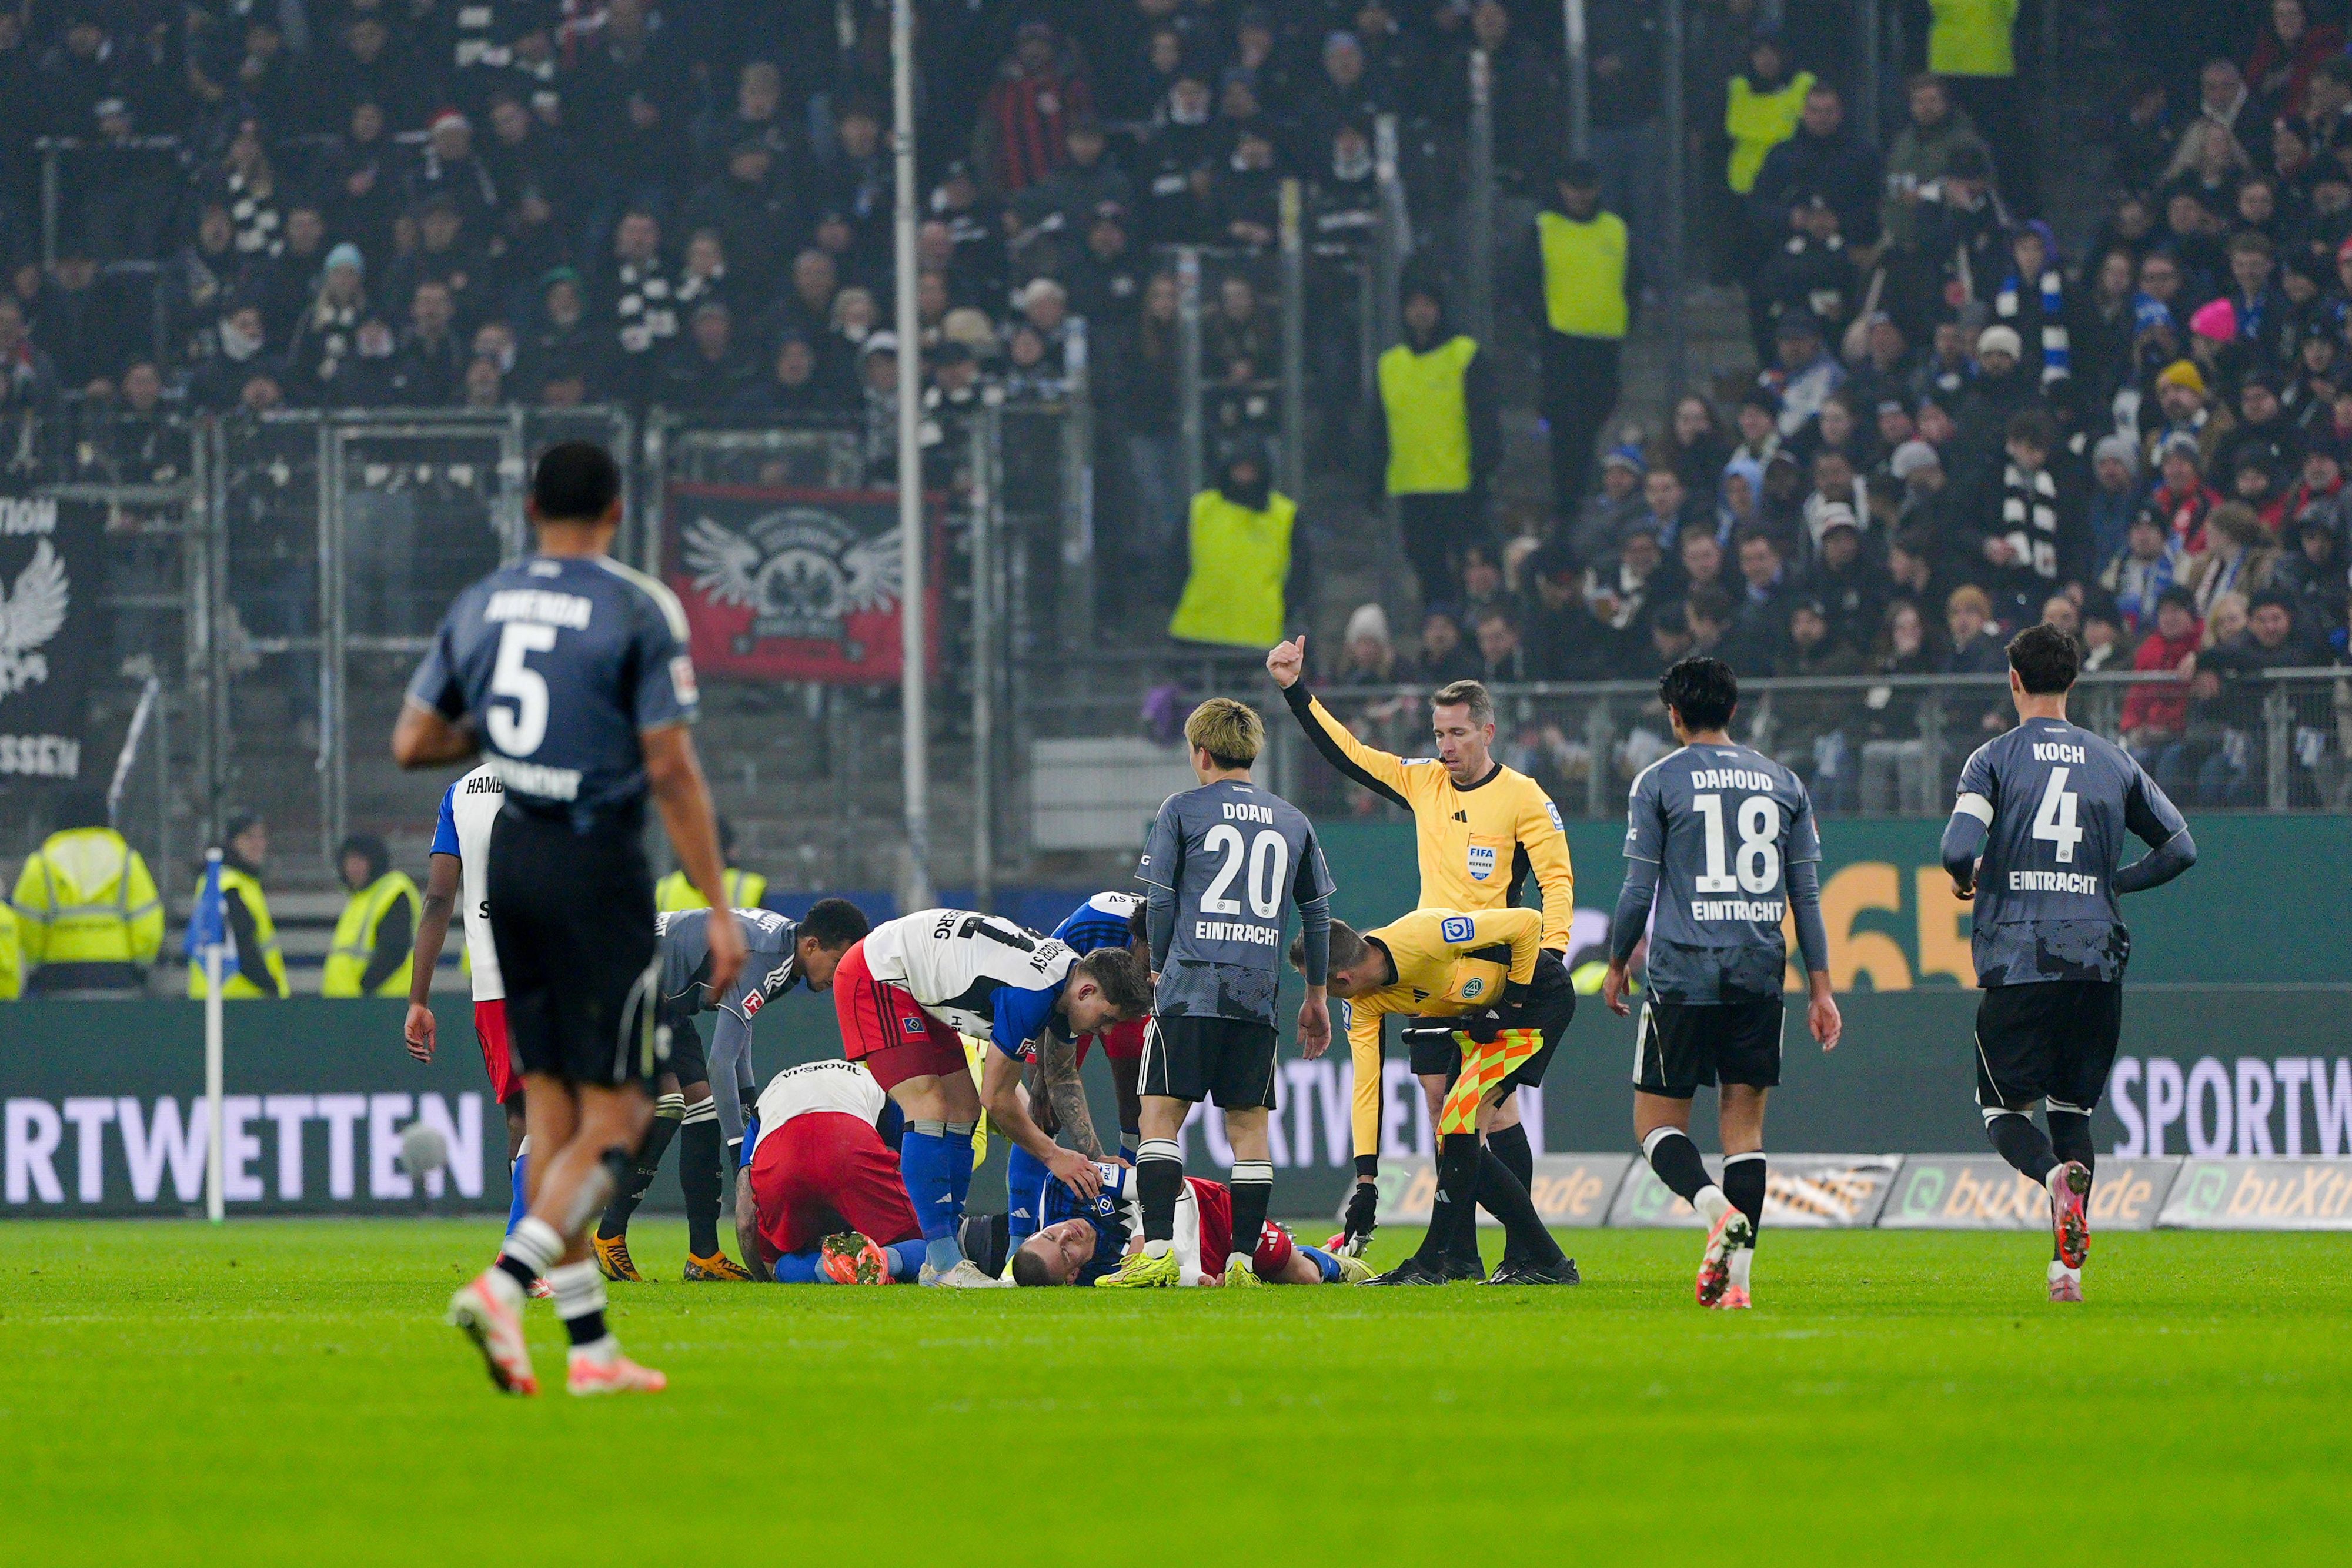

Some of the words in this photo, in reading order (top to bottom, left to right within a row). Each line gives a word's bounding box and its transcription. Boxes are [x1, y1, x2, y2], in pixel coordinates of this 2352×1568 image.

[487, 623, 557, 757] 5
[2032, 742, 2086, 764] KOCH
[1690, 768, 1773, 791] DAHOUD
[1222, 802, 1273, 824] DOAN
[2032, 767, 2083, 863] 4
[1470, 848, 1493, 858] FIFA
[1692, 794, 1780, 894] 18
[1200, 824, 1289, 919] 20
[2009, 871, 2097, 895] EINTRACHT
[1690, 900, 1783, 922] EINTRACHT
[1195, 921, 1279, 947] EINTRACHT
[5, 1092, 483, 1203] RTWETTEN
